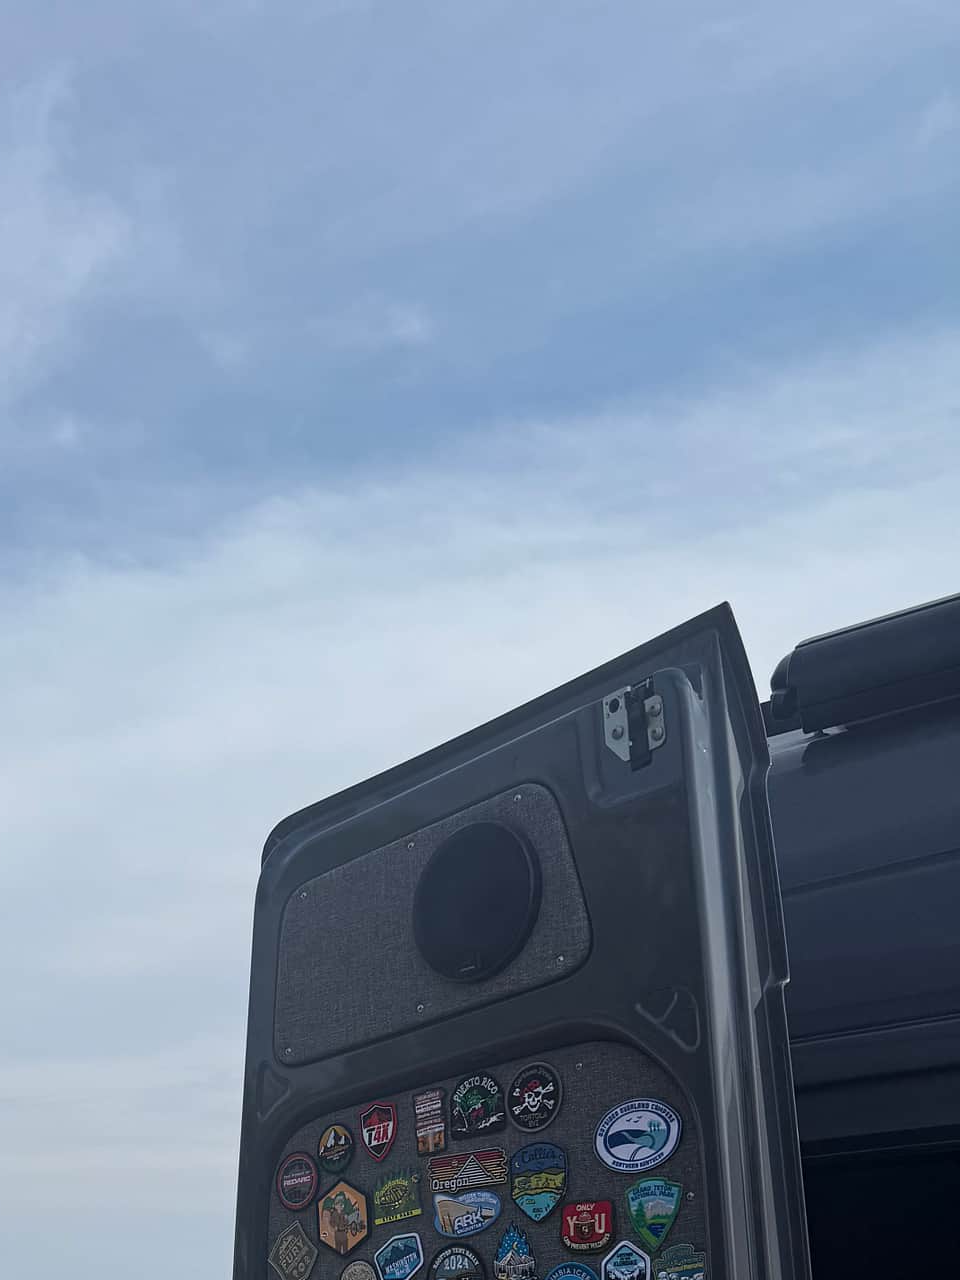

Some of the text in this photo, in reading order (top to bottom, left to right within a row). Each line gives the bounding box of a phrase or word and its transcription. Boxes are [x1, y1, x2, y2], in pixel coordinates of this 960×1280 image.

[453, 1077, 479, 1102] PUERTO
[482, 1077, 499, 1094] RICO
[431, 1176, 469, 1192] Oregon
[653, 1183, 673, 1192] TETON
[631, 1192, 657, 1202] NATIONAL
[454, 1213, 484, 1230] ARK
[432, 1248, 450, 1269] ROOFTOP
[464, 1249, 480, 1265] RALLY
[443, 1256, 469, 1270] 2024
